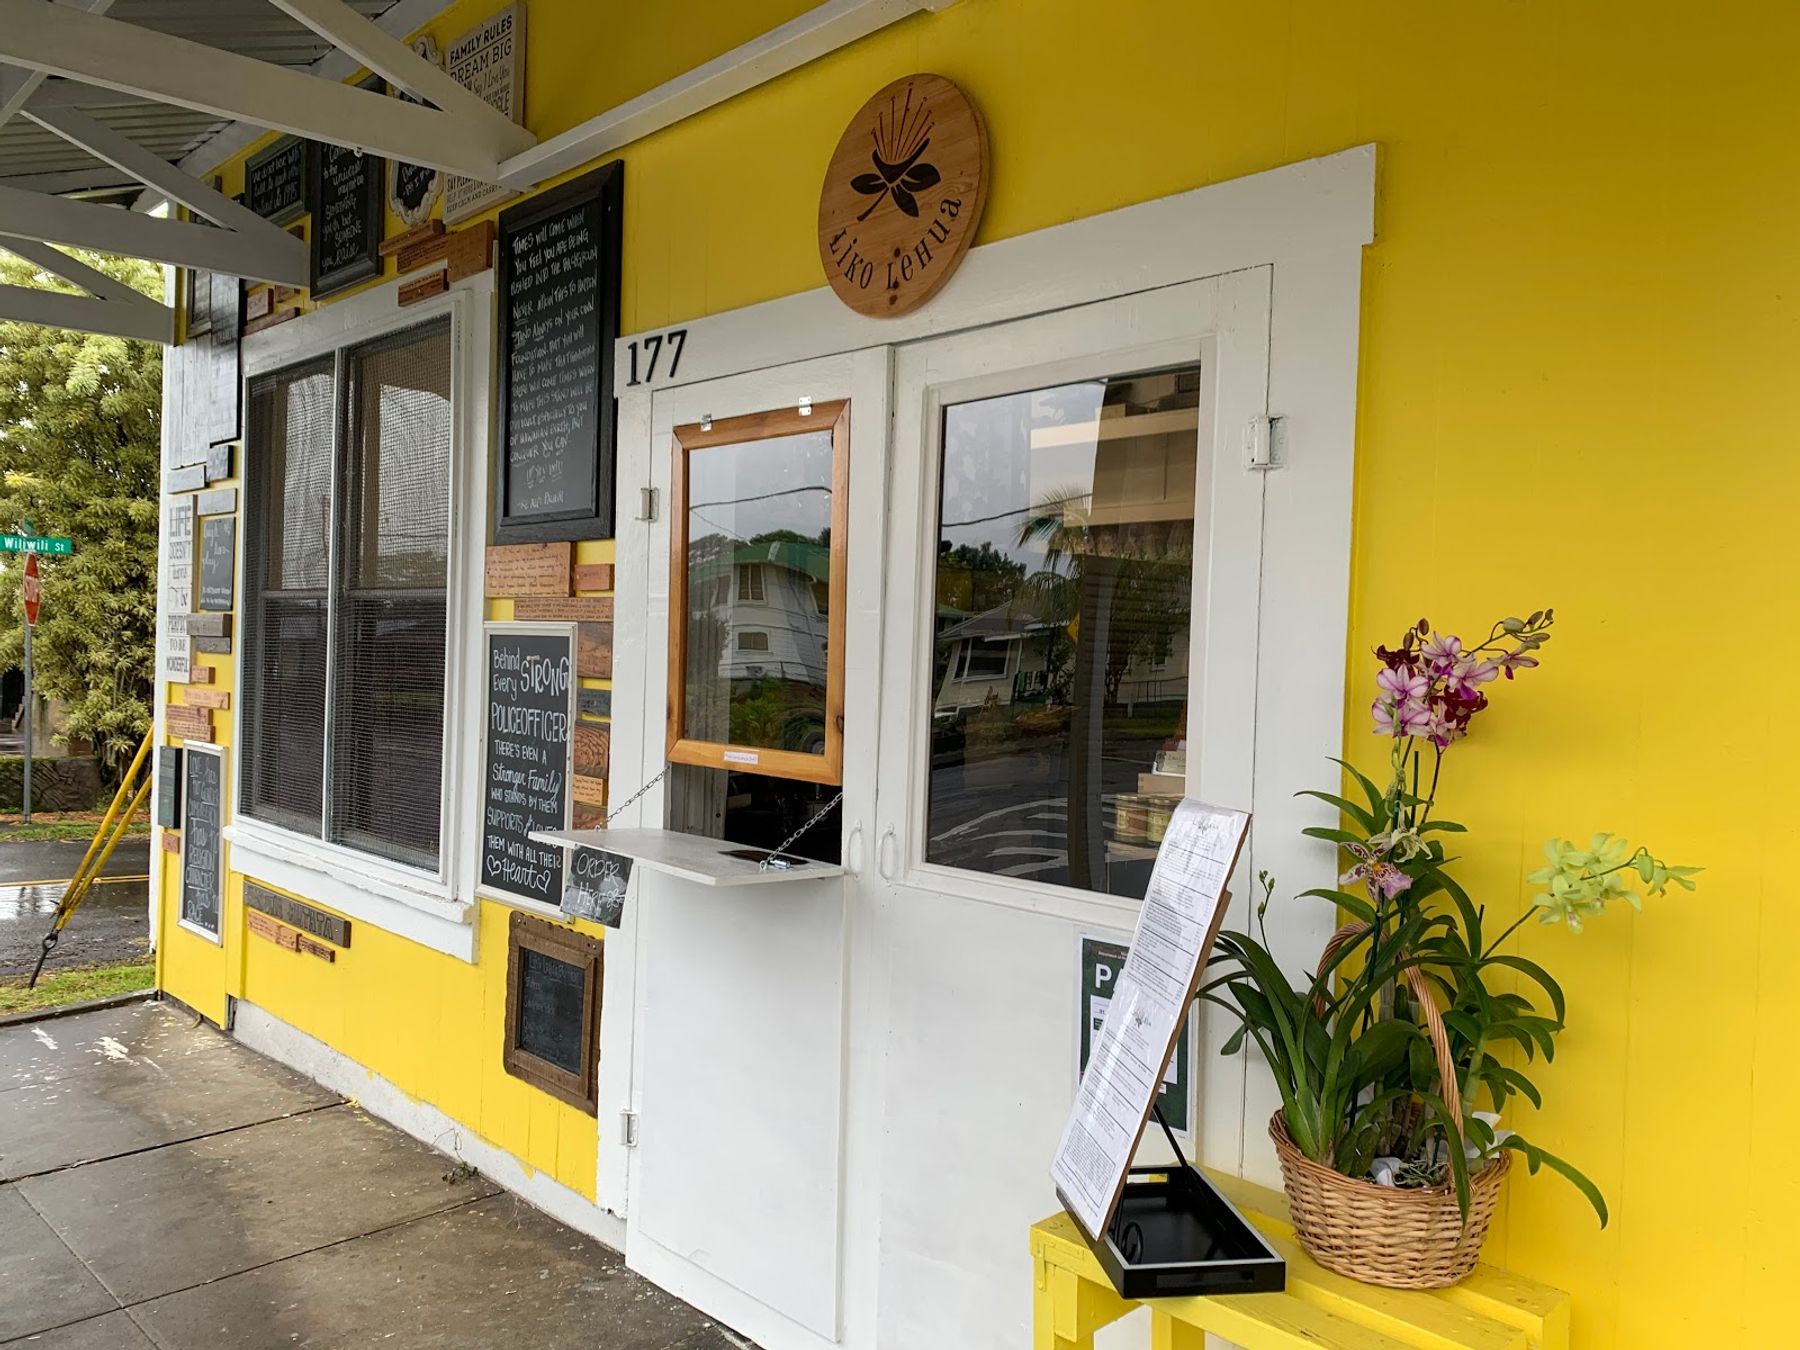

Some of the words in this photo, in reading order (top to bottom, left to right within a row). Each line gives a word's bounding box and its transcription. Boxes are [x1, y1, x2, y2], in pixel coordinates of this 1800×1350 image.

[450, 34, 482, 64] FAMILY
[484, 14, 512, 44] RULES
[450, 51, 489, 82] DREAM
[492, 38, 512, 64] BIG
[472, 191, 482, 203] AND
[512, 232, 534, 255] TIMES
[549, 217, 565, 237] COME
[569, 279, 576, 296] TO
[626, 328, 688, 387] 177
[169, 505, 191, 538] LIFE
[4, 537, 49, 551] Wiliwili
[54, 542, 65, 552] St
[493, 646, 520, 671] Behind
[493, 674, 517, 701] Every
[520, 655, 569, 696] STRONG
[494, 739, 520, 758] THERE'S
[522, 745, 539, 763] EVEN
[542, 749, 547, 766] A
[492, 762, 527, 792] Stronger
[528, 769, 562, 801] Family
[491, 788, 503, 801] WHO
[504, 789, 527, 807] STANDS
[528, 795, 538, 811] BY
[538, 797, 558, 814] THEM
[487, 806, 524, 834] SUPPORTS
[487, 835, 505, 851] THEM
[507, 840, 523, 859] WITH
[525, 844, 537, 864] ALL
[501, 858, 537, 889] Heart
[576, 852, 620, 887] ORDER
[577, 881, 607, 917] HERE
